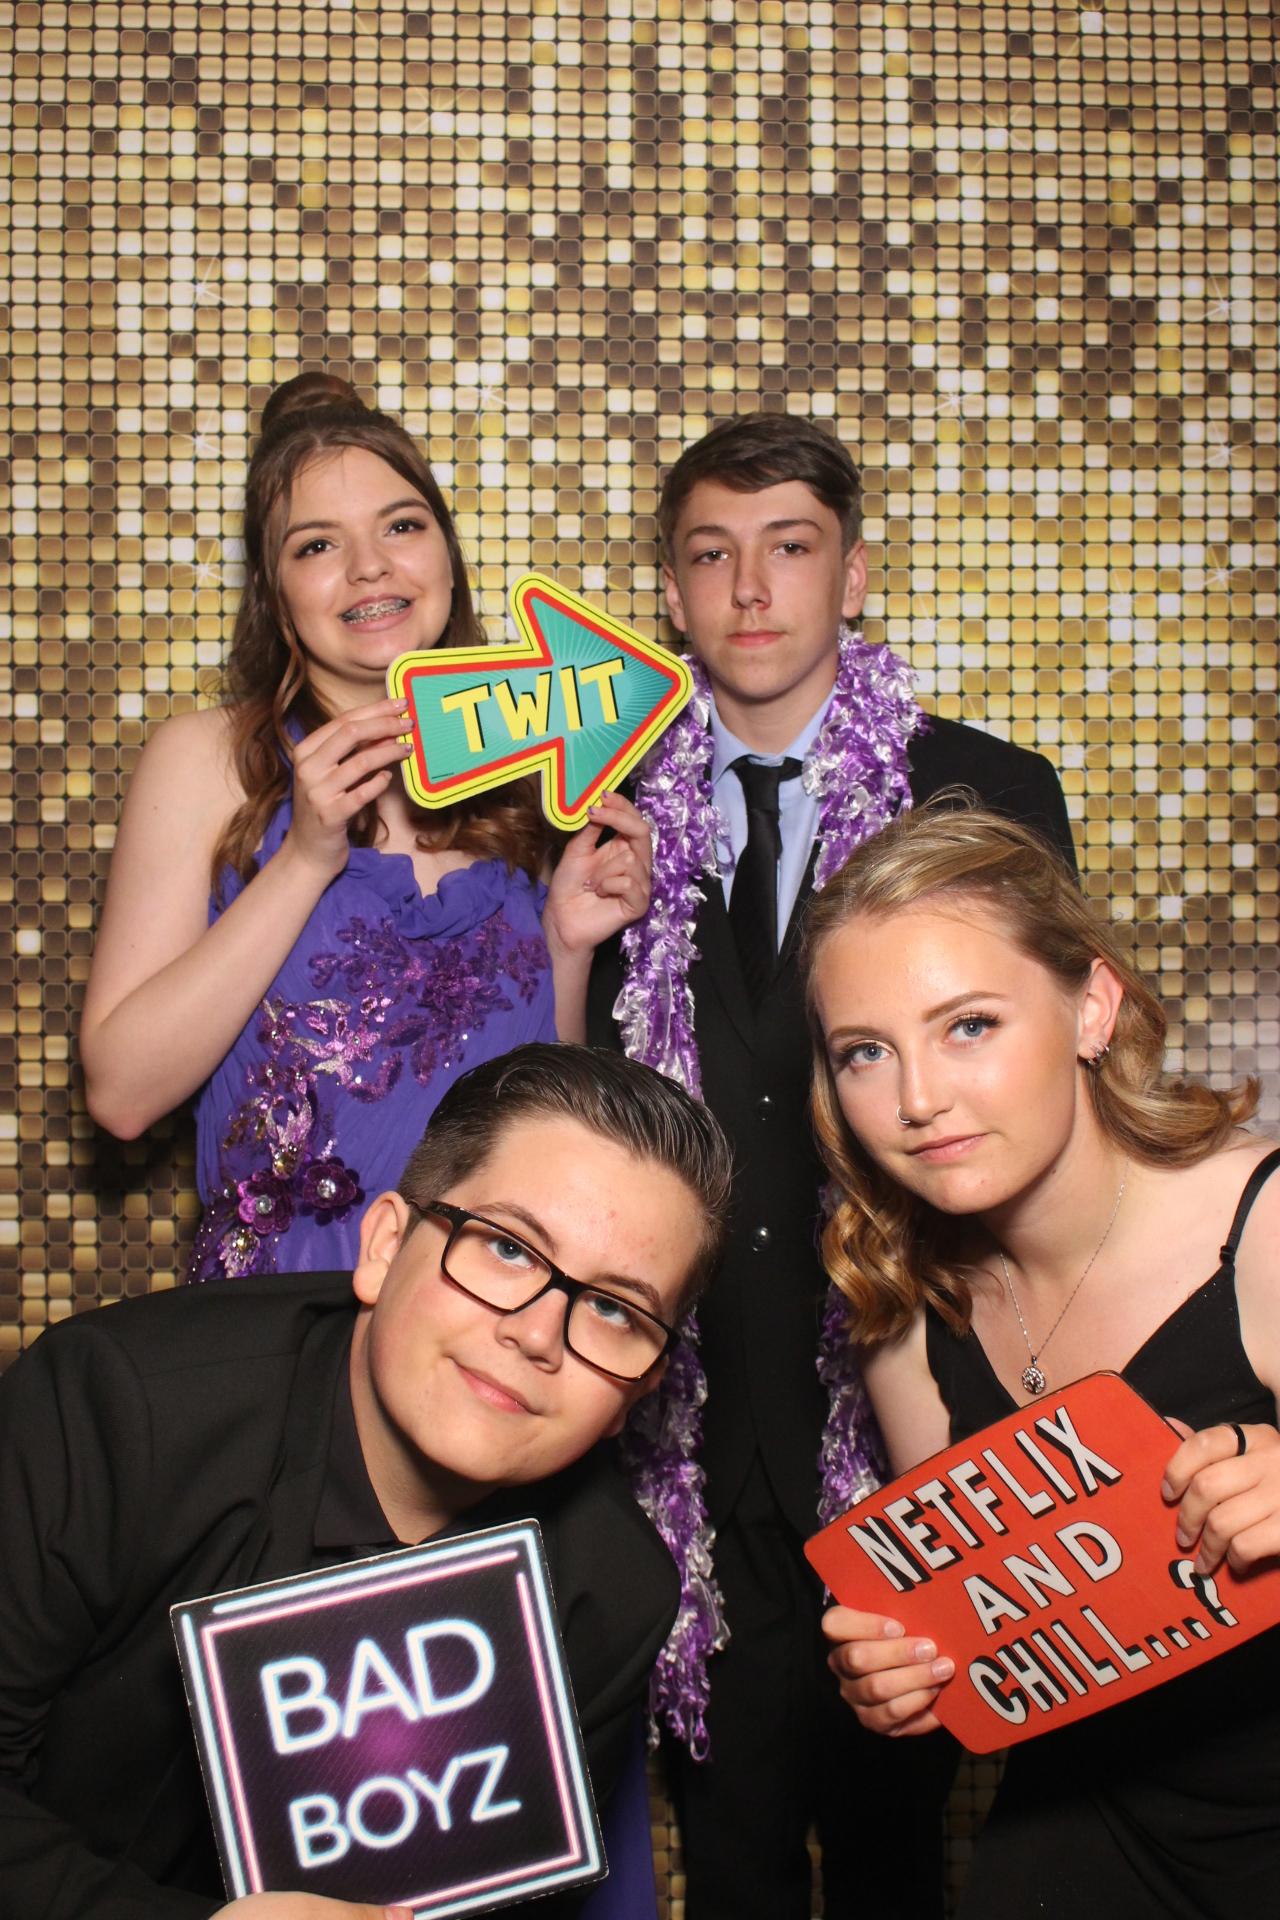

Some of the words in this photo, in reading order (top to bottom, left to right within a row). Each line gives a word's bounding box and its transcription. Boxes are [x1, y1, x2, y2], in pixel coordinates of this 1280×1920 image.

[441, 657, 625, 752] TWIT
[847, 1406, 1123, 1592] NETFLIX
[963, 1521, 1124, 1636] AND
[261, 1619, 495, 1755] BAD
[289, 1745, 522, 1868] BOYZ
